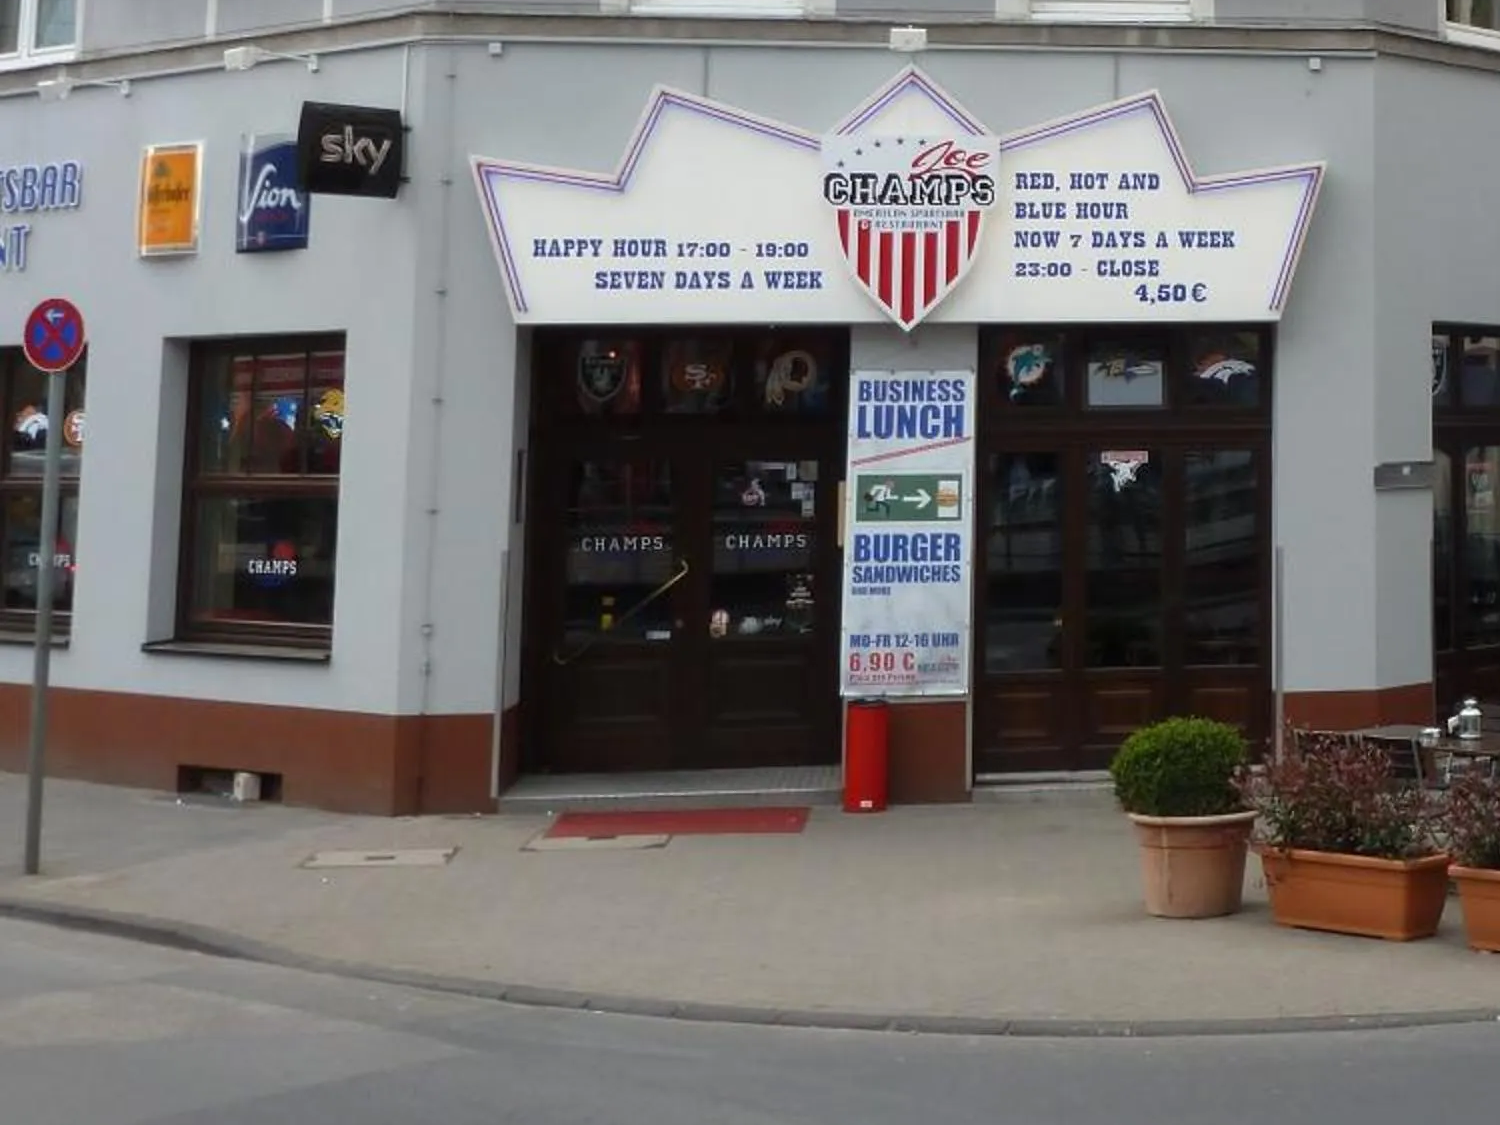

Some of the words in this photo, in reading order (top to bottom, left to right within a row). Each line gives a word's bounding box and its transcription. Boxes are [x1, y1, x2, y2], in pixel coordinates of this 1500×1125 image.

[320, 124, 392, 174] sky
[908, 140, 990, 181] Joe
[824, 173, 995, 206] CHAMPS
[1070, 173, 1109, 190] HOT
[1118, 173, 1160, 190] AND
[1015, 202, 1067, 219] BLUE
[1076, 202, 1129, 219] HOUR
[532, 239, 602, 257] HAPPY
[613, 239, 667, 257] HOUR
[677, 242, 731, 258] 17:00
[755, 242, 809, 258] 19:00
[1014, 231, 1060, 248] NOW
[1070, 234, 1082, 248] 7
[1092, 231, 1146, 248] DAYS
[1156, 231, 1168, 248] A
[1178, 231, 1235, 248] WEEK
[1015, 262, 1072, 277] 23:00
[1097, 260, 1160, 277] CLOSE
[595, 271, 665, 290] SEVEN
[675, 271, 731, 290] DAYS
[741, 271, 754, 289] A
[764, 271, 823, 290] WEEK
[858, 379, 965, 402] BUSINESS
[858, 405, 964, 439] LUNCH
[582, 536, 664, 553] CHAMPS
[725, 534, 807, 550] CHAMPS
[853, 533, 961, 562] BURGER
[249, 560, 297, 574] CHAMPS
[852, 565, 961, 583] SANDWICHES
[932, 633, 959, 648] UHR
